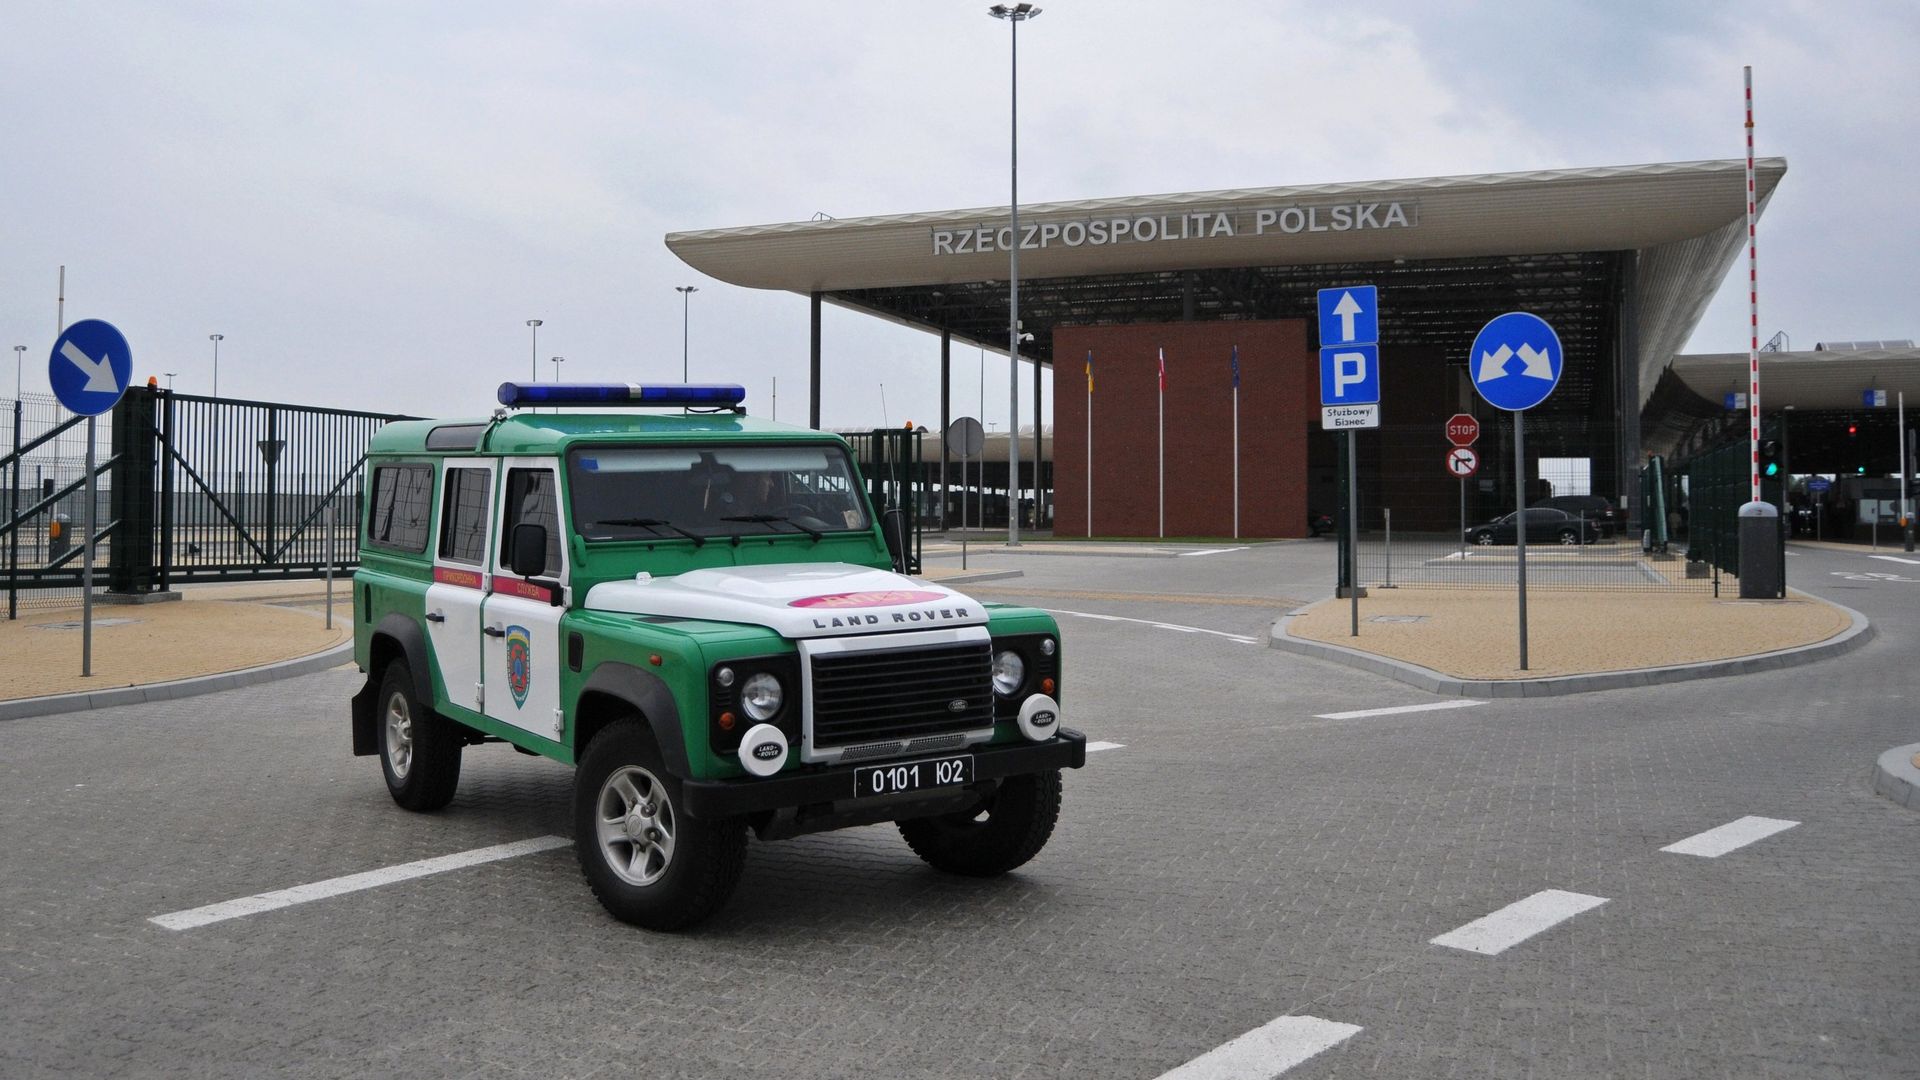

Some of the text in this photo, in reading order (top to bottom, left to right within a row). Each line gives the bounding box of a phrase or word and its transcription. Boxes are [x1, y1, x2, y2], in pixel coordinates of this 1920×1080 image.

[933, 202, 1408, 255] RZECZPOSPOLITA POLSKA
[1334, 353, 1366, 397] P
[1450, 425, 1476, 435] STOP
[813, 607, 969, 629] LAND ROVER
[872, 759, 963, 793] 0101 Ю2
